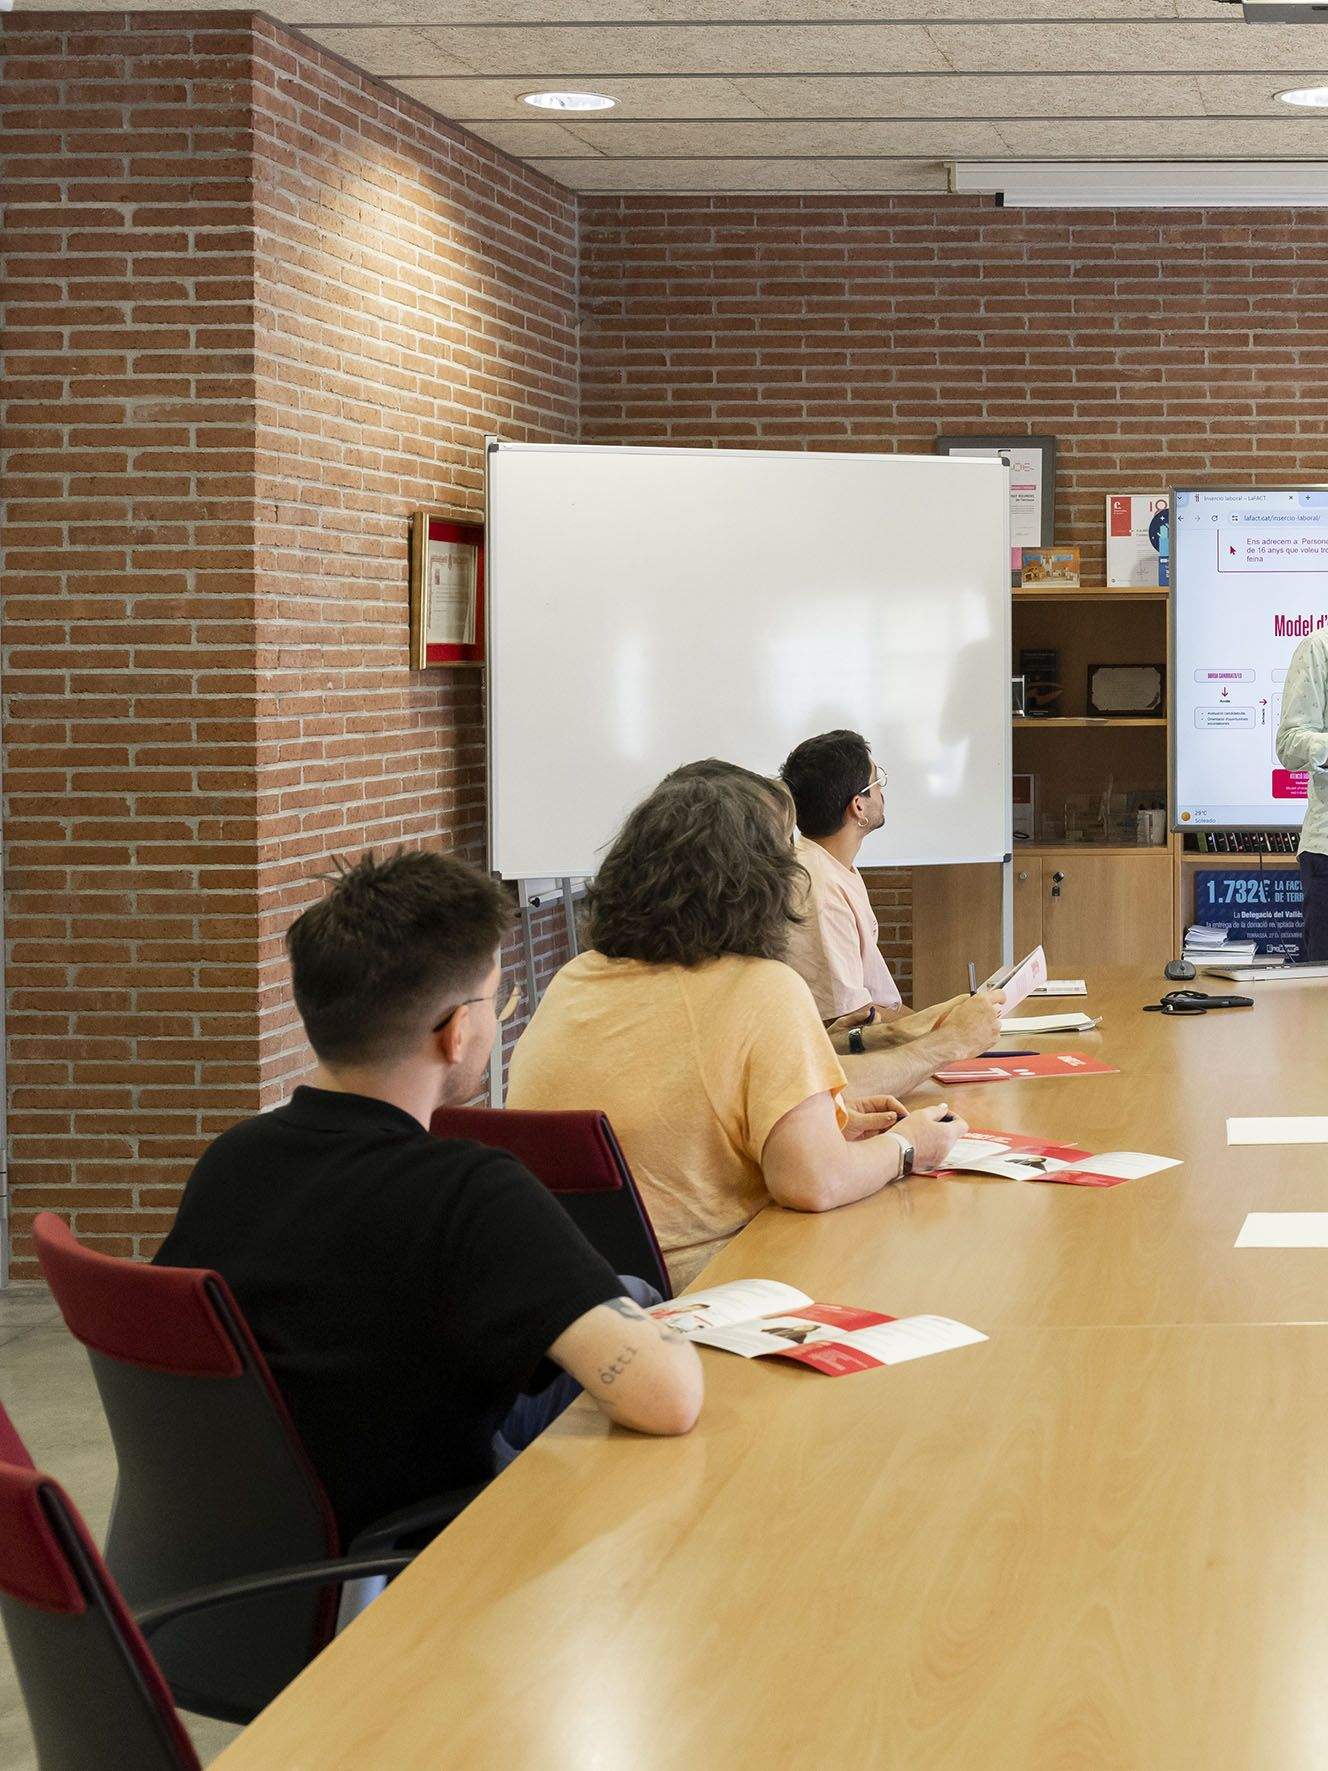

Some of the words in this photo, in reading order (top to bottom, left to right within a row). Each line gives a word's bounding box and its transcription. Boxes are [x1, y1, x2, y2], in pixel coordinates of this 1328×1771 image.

[1274, 614, 1313, 637] Model
[1274, 880, 1284, 891] LA
[1274, 892, 1284, 903] DE
[1233, 911, 1241, 919] La
[1241, 911, 1273, 919] Delegació
